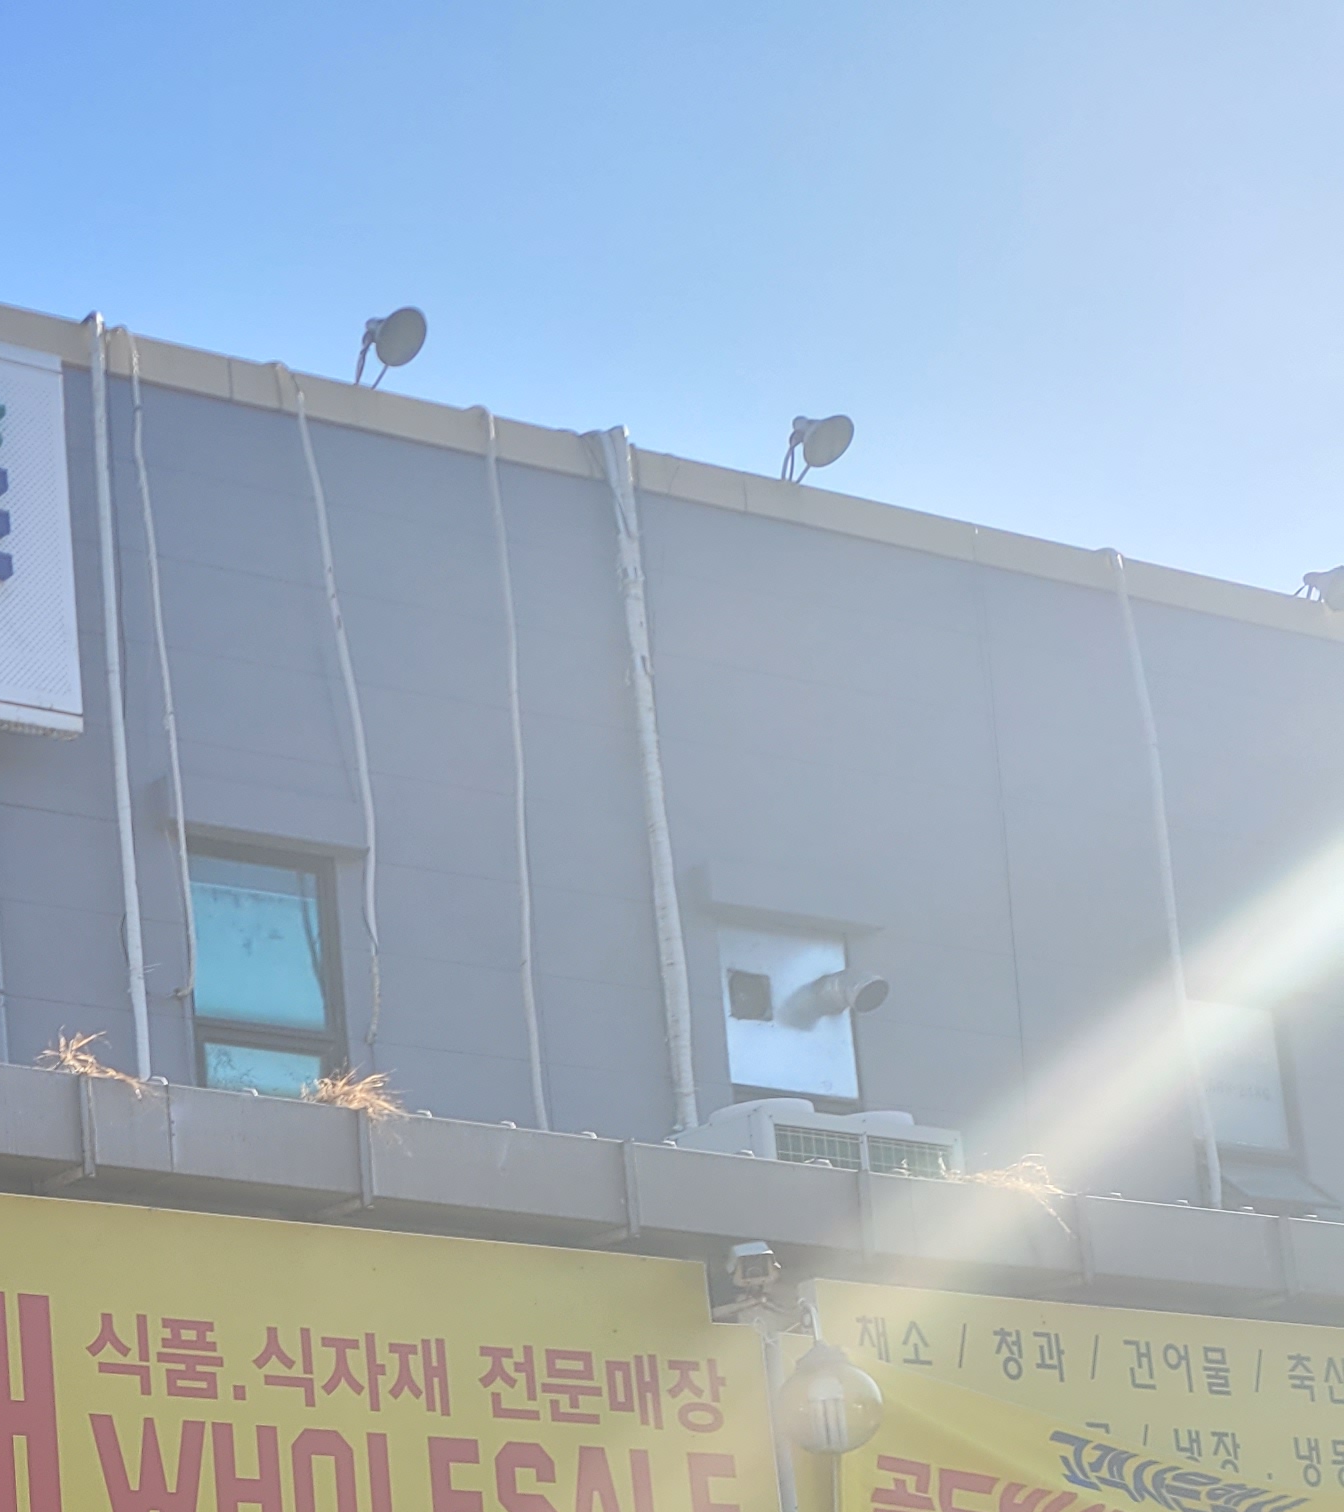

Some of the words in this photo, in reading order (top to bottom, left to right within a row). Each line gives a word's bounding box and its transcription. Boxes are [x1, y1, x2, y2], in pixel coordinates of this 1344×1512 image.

[476, 1342, 728, 1436] 전문매장
[857, 1314, 933, 1368] 채소
[993, 1326, 1066, 1383] 청과
[1123, 1338, 1232, 1397] 건어물
